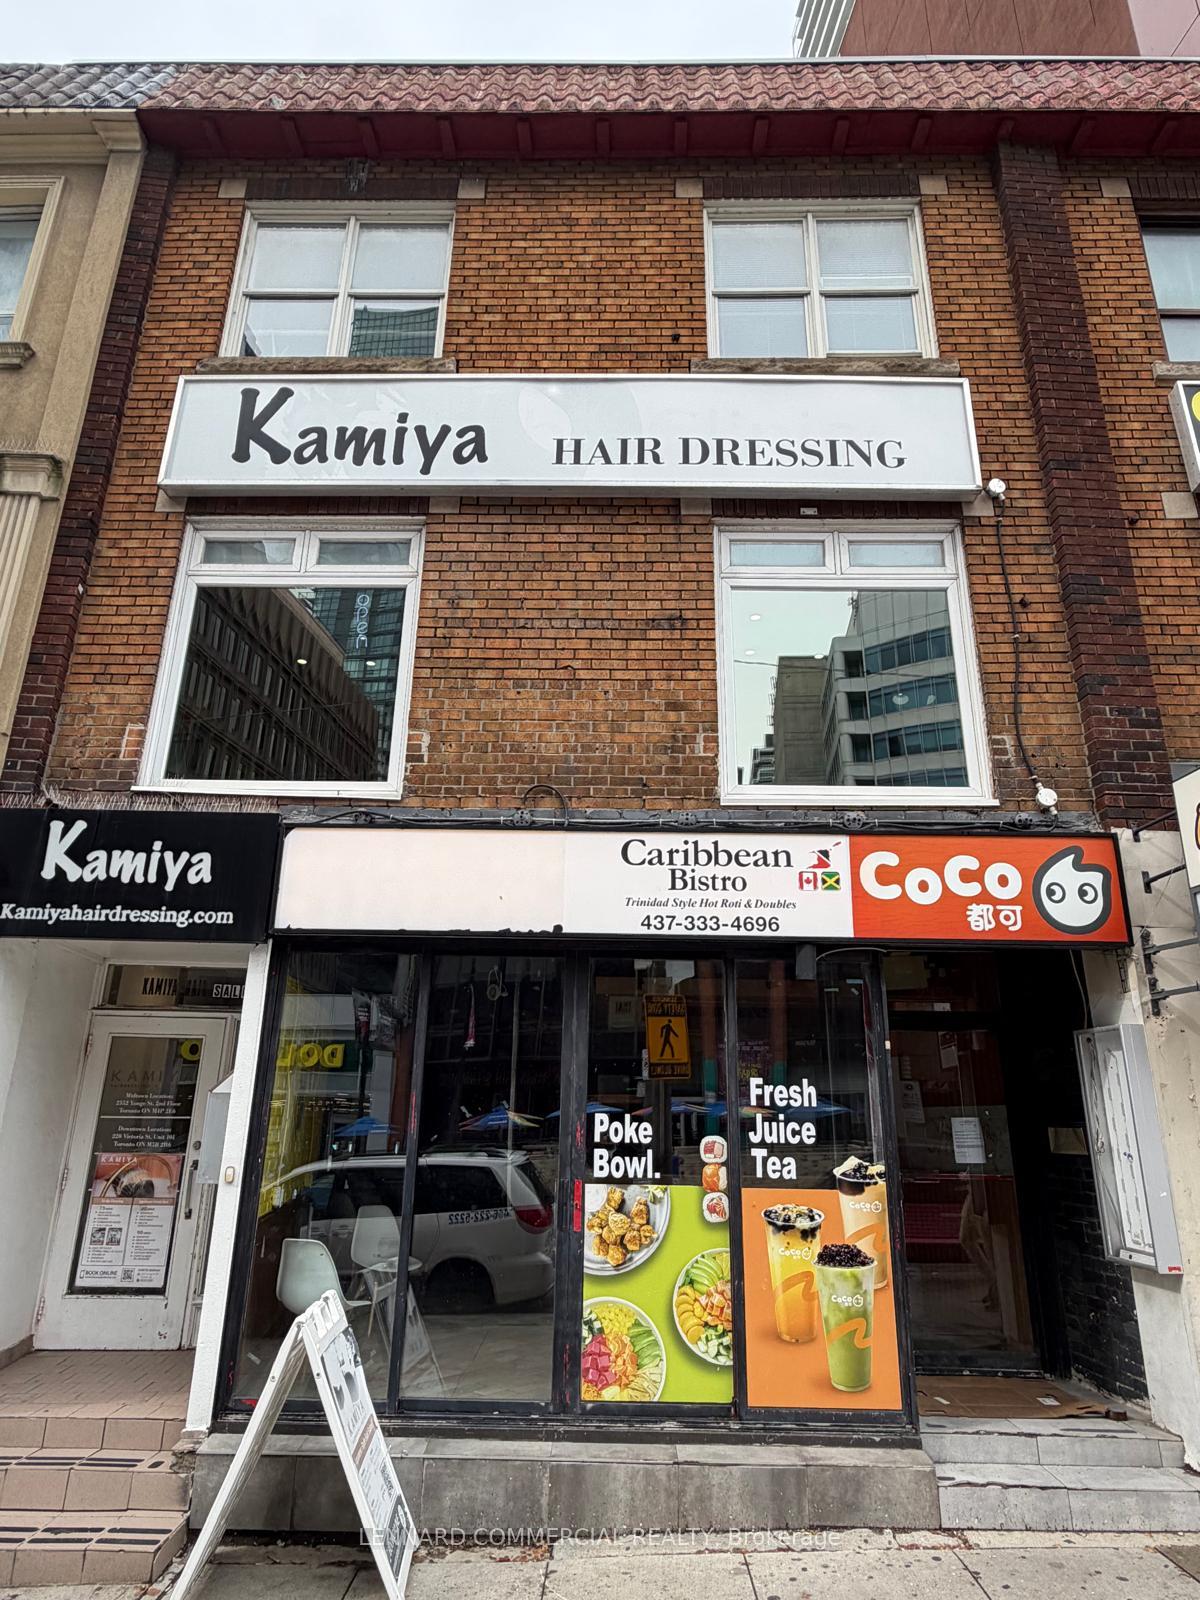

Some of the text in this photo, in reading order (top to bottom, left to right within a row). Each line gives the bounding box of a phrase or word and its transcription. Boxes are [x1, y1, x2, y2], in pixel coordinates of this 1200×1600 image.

[231, 386, 489, 476] Kamiya
[552, 436, 908, 470] HAIR DRESSING
[41, 819, 212, 892] Kamiya
[620, 838, 794, 869] Caribbean
[668, 868, 747, 892] Bistro
[859, 850, 1023, 905] CoCo
[0, 902, 234, 928] Kamiyahairdressing.com
[625, 896, 797, 911] Trinidad Style Hot Roti & Doubles
[966, 903, 1023, 931] 都可
[640, 914, 780, 932] 437-333-4696
[750, 1077, 817, 1107] Fresh
[593, 1113, 653, 1144] Poke
[748, 1113, 817, 1144] Juice
[593, 1148, 661, 1179] Bowl.
[750, 1148, 797, 1180] Tea
